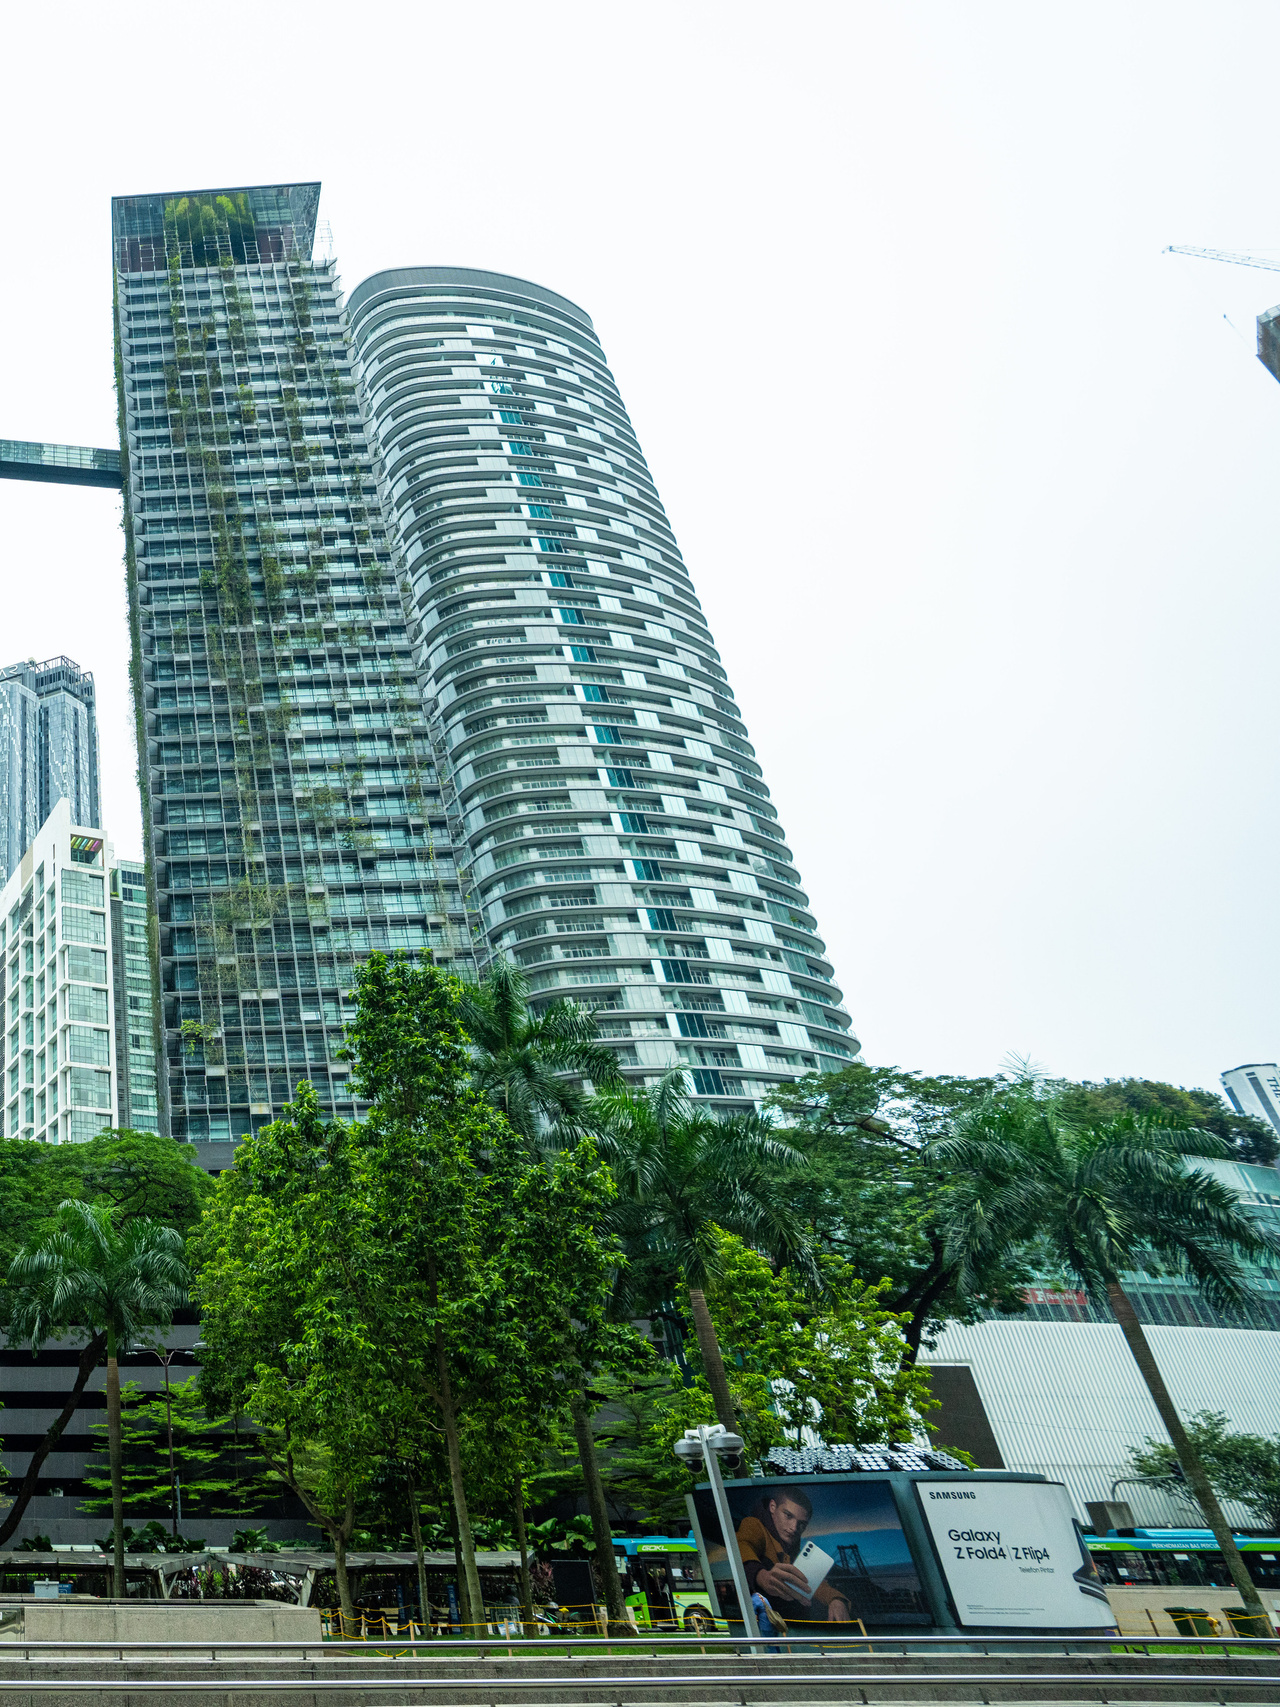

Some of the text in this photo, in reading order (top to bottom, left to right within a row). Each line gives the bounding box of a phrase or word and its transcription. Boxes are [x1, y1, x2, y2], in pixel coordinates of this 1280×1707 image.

[929, 1491, 976, 1500] SAMSUNG
[948, 1529, 1001, 1545] Galaxy
[953, 1546, 1050, 1564] Z Fold4 Z Flip4
